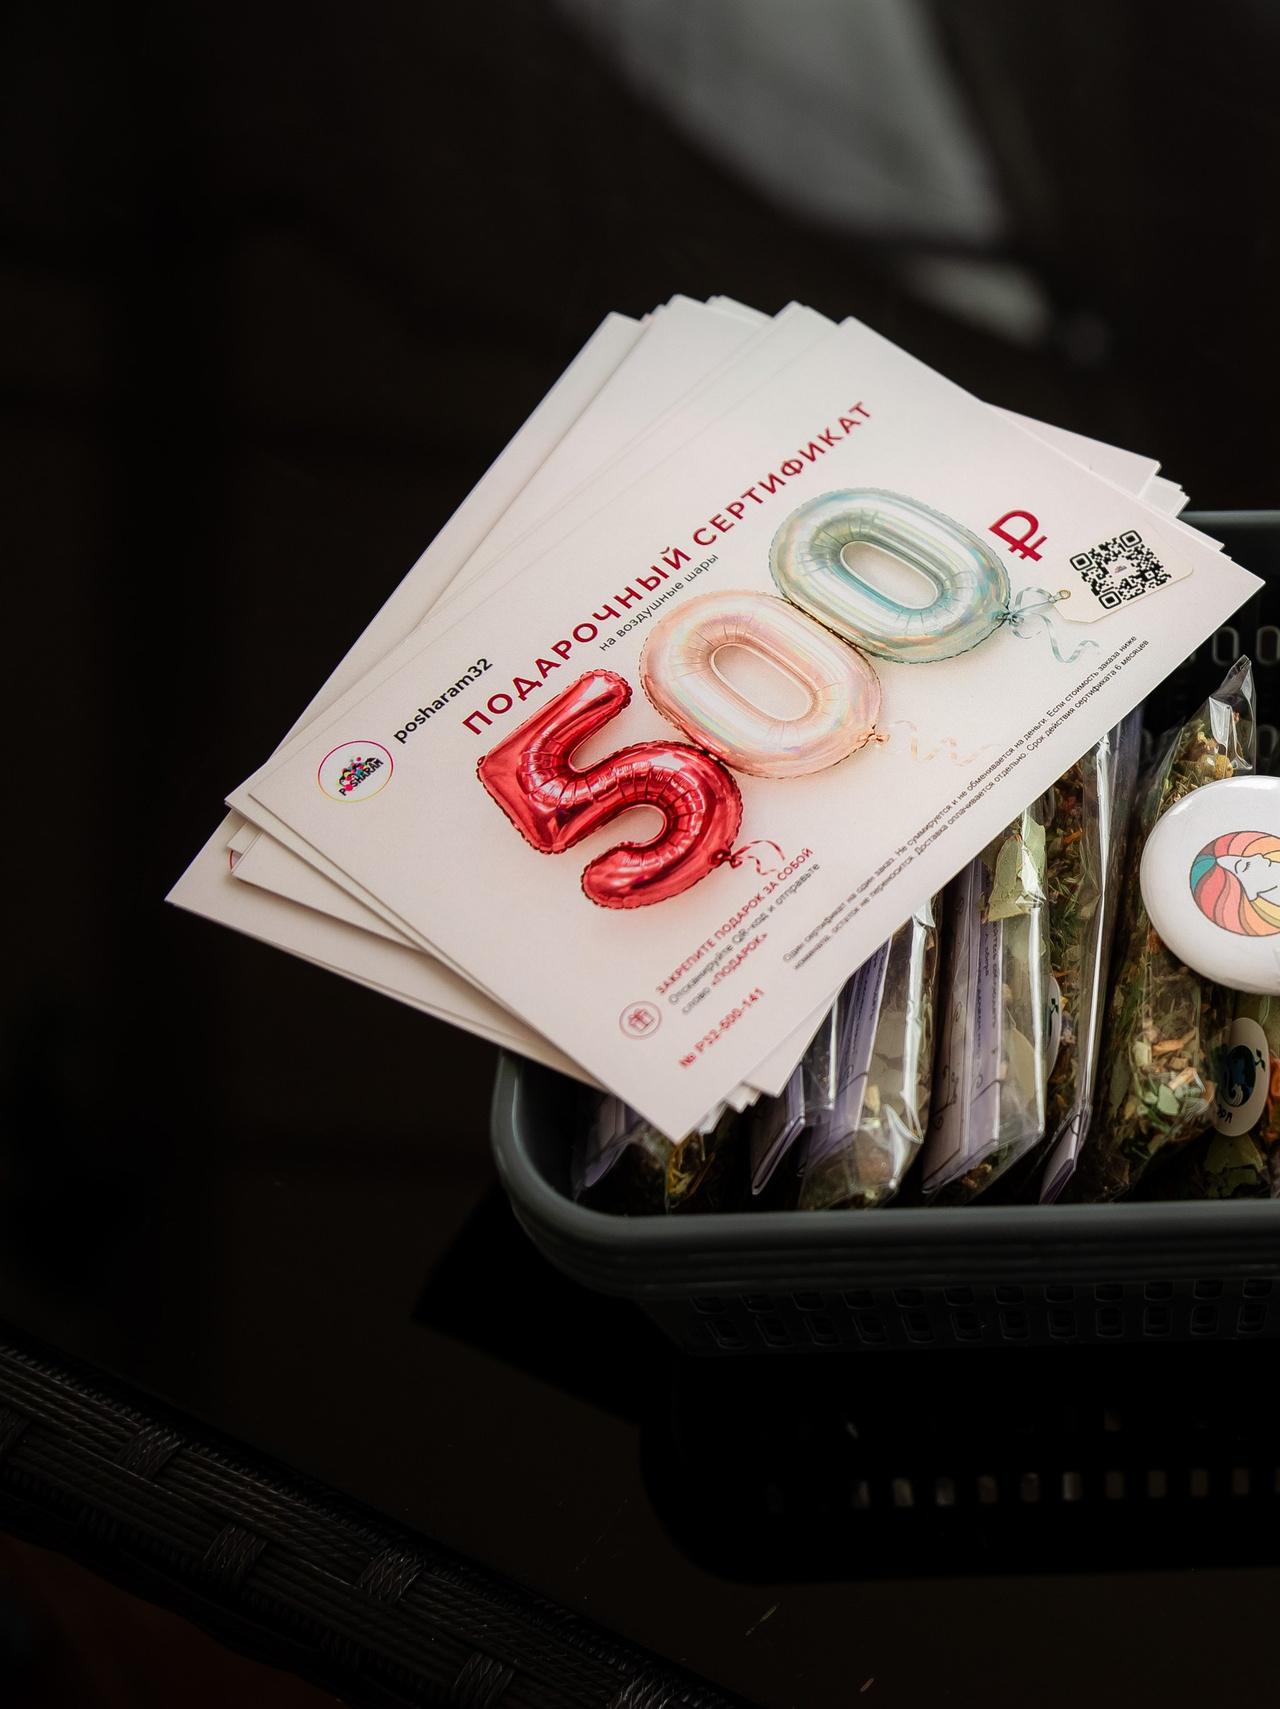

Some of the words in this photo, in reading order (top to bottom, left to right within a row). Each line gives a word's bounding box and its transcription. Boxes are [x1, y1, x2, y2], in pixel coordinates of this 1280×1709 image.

[462, 546, 692, 735] ПОДАРОЧНЫЙ
[692, 401, 872, 547] СЕРТИФИКАТ
[599, 634, 617, 652] на
[616, 580, 684, 638] воздушные
[683, 554, 719, 584] шары
[393, 658, 493, 744] posharam32
[477, 487, 1016, 912] 500
[782, 942, 806, 964] Один
[804, 902, 847, 943] сертификат
[847, 892, 857, 903] на
[856, 874, 875, 894] один
[874, 855, 897, 877] заказ.
[895, 844, 908, 856] Не
[906, 804, 952, 847] суммируется
[957, 790, 968, 801] не
[967, 746, 1015, 792] обменивается
[1014, 738, 1025, 749] на
[1024, 716, 1049, 742] деньги.
[1046, 700, 1066, 718] Если
[1065, 670, 1100, 702] стоимость
[1097, 652, 1121, 672] заказа
[1119, 635, 1137, 653] ниже
[794, 932, 833, 971] номинала,
[831, 907, 860, 935] остаток
[860, 897, 870, 908] не
[869, 855, 916, 899] переносится.
[914, 824, 949, 856] Доставка
[947, 782, 996, 825] оплачивается
[994, 752, 1029, 783] отдельно.
[1026, 734, 1046, 752] Срок
[1044, 707, 1075, 737] действия
[1074, 669, 1118, 709] сертификата
[1120, 639, 1150, 667] месяцев
[656, 938, 717, 995] ЗАКРЕПИТЕ
[714, 893, 766, 940] ПОДАРОК
[763, 880, 779, 895] ЗА
[777, 848, 814, 881] СОБОЙ
[668, 944, 733, 1005] Отсканируйте
[732, 912, 769, 946] QR-код
[775, 862, 821, 905] отправьте
[681, 986, 712, 1015] слово
